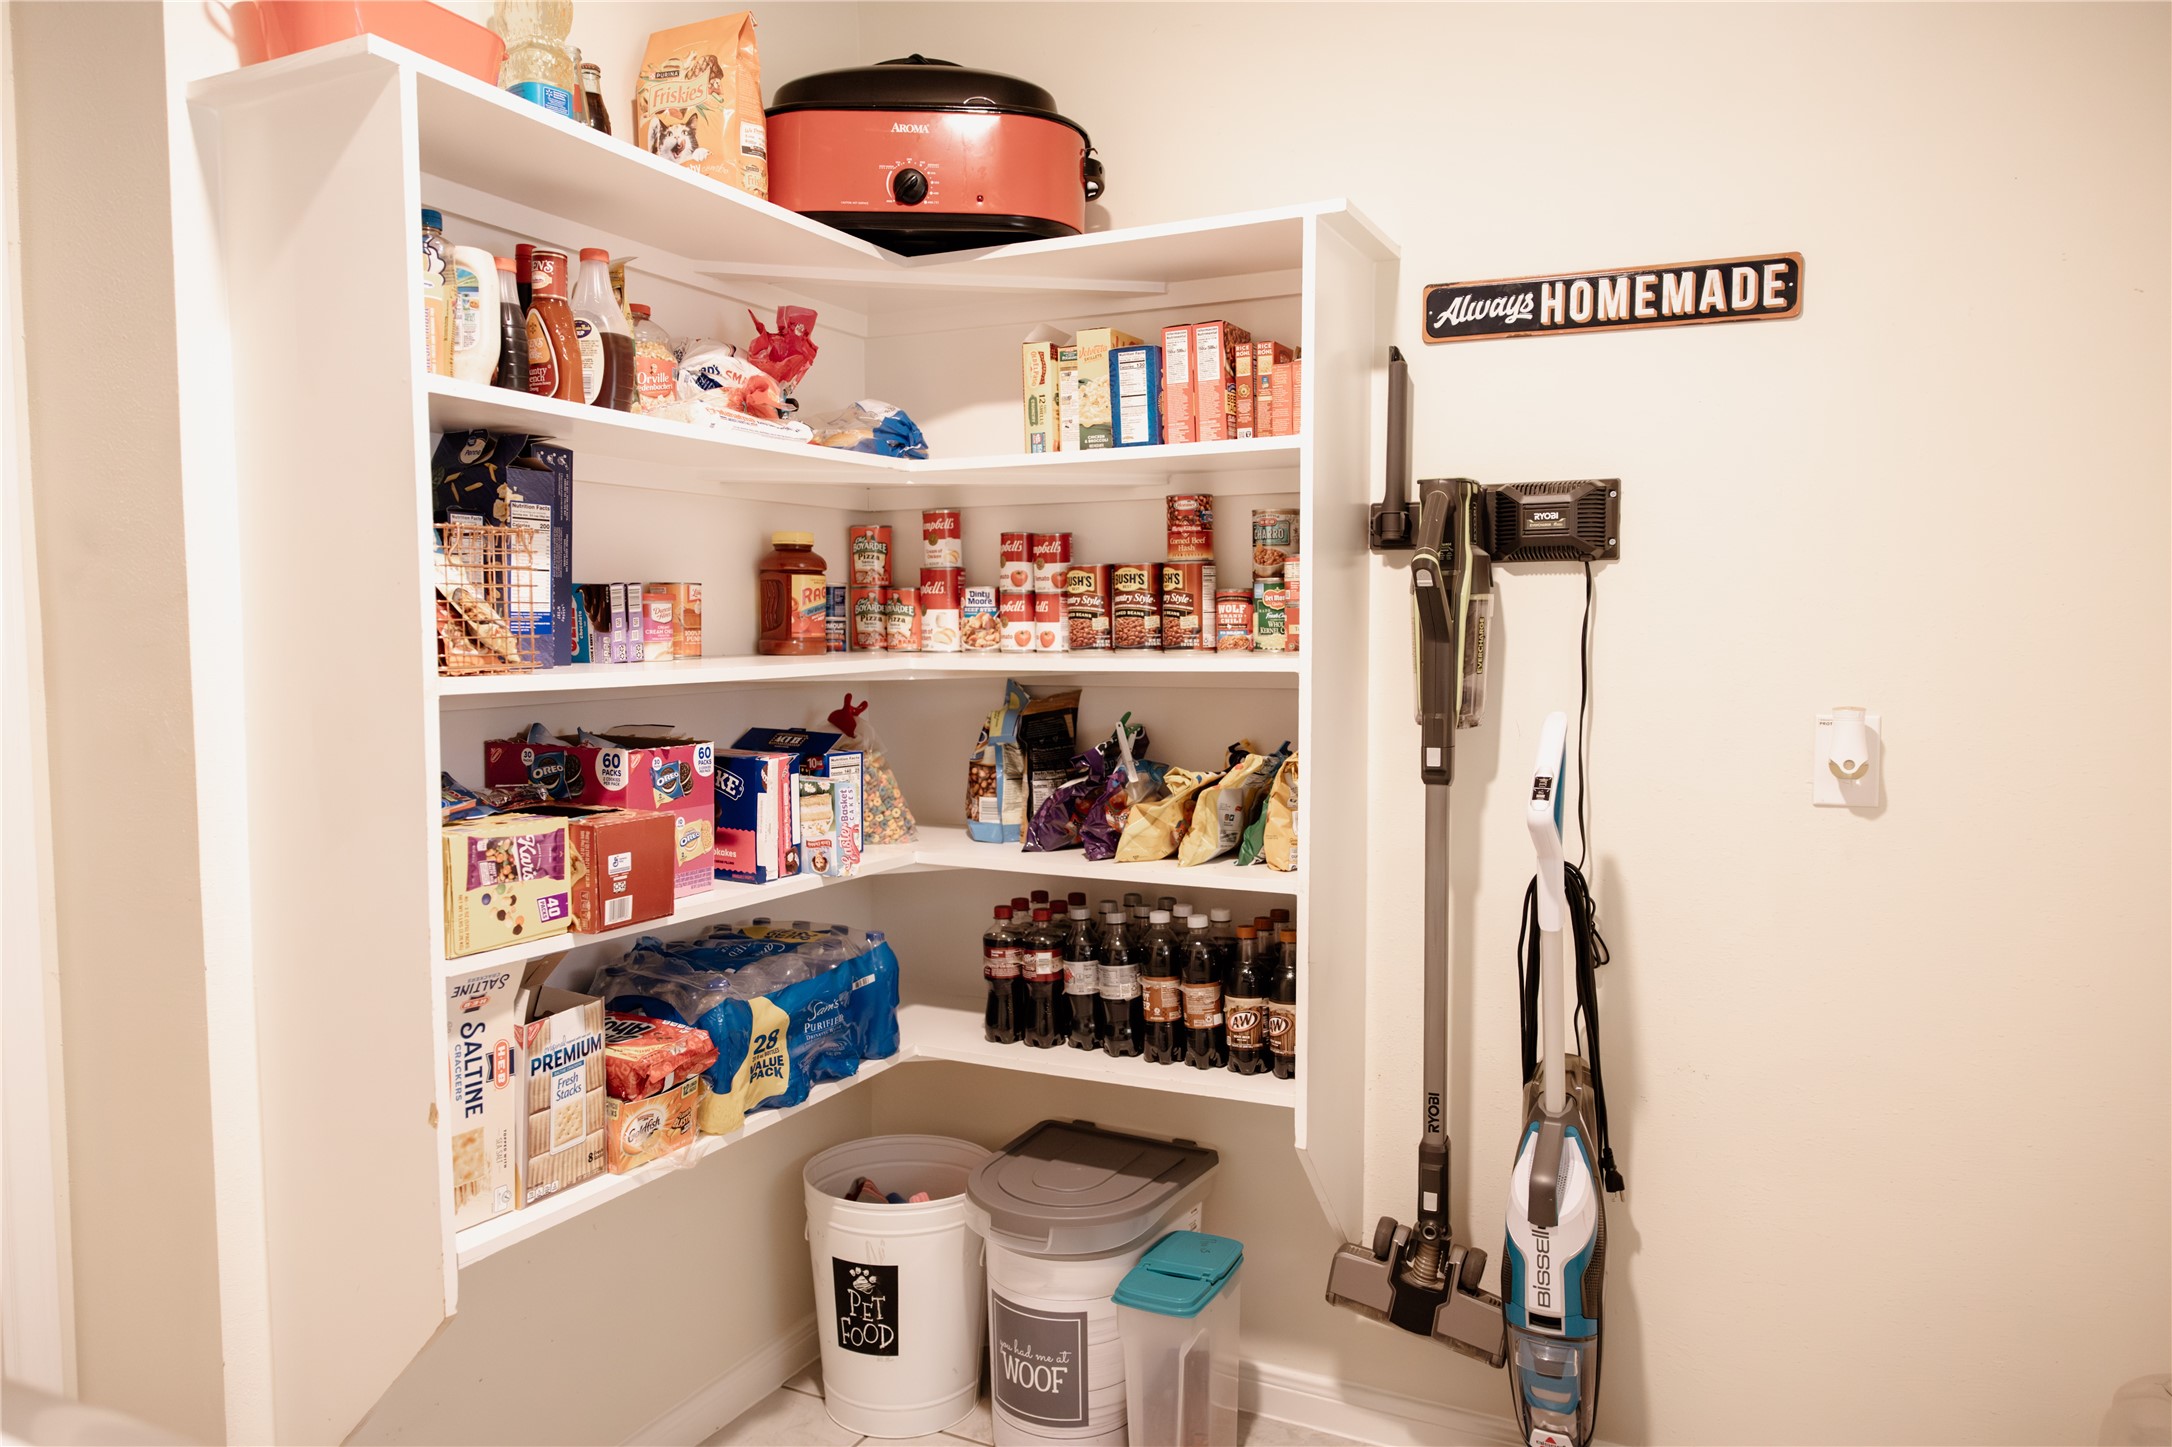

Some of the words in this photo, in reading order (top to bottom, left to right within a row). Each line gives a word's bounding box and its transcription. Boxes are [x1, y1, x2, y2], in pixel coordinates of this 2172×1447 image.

[656, 70, 679, 78] PURINA
[653, 84, 704, 107] Friskies
[891, 122, 930, 133] AROMA
[531, 260, 554, 273] EN'S
[1433, 291, 1534, 328] Always
[1540, 263, 1788, 325] HOMEMADE
[637, 372, 669, 384] Orville
[1039, 394, 1046, 403] 12
[512, 502, 535, 510] Nutrition
[1534, 512, 1559, 520] RYOBI
[1170, 537, 1190, 545] Corned
[1254, 528, 1284, 540] CHARRO
[853, 542, 887, 553] BOYARDEE
[1178, 544, 1196, 552] Hash
[858, 553, 880, 561] Pizza
[1068, 575, 1093, 587] USH'S
[1115, 573, 1145, 585] BUSH'S
[969, 590, 991, 600] Dinty
[1081, 595, 1101, 606] Style
[1133, 592, 1154, 604] Style
[1171, 593, 1190, 604] Style
[855, 604, 886, 614] BOYARDE
[1218, 604, 1246, 614] WOLF
[861, 614, 883, 623] Pizza
[1477, 617, 1485, 674] EVERCHARGE
[698, 746, 712, 760] 60
[602, 753, 621, 769] 60
[808, 757, 817, 768] 10
[532, 764, 564, 779] OREO
[601, 768, 621, 777] PACKS
[656, 772, 679, 787] OREO
[840, 789, 849, 821] Basket
[680, 833, 701, 847] OREO
[839, 822, 860, 871] Easter
[517, 834, 537, 881] Kar's
[540, 901, 548, 920] PACKS
[547, 897, 561, 918] 40
[467, 973, 501, 983] CRACKERS
[451, 973, 510, 998] SALTINE
[808, 999, 840, 1022] Sam's
[804, 1014, 845, 1034] PURIFIED
[753, 1028, 780, 1055] 28
[531, 1033, 602, 1077] PREMIUM
[765, 1048, 780, 1058] BOTTLES
[460, 1022, 486, 1119] SALTINE
[750, 1055, 785, 1075] VALUE
[557, 1072, 579, 1090] Fresh
[750, 1067, 784, 1084] PACK
[555, 1083, 582, 1102] Stacks
[683, 1083, 690, 1096] 12
[1428, 1092, 1440, 1133] RYOBI
[628, 1116, 661, 1143] Goldfish
[588, 1152, 593, 1164] 8
[847, 1288, 886, 1322] PET
[841, 1316, 895, 1350] FOOD
[1000, 1339, 1013, 1354] you
[1013, 1339, 1034, 1359] had
[1035, 1353, 1054, 1363] me
[1056, 1351, 1072, 1364] at
[1000, 1351, 1068, 1394] WOOF
